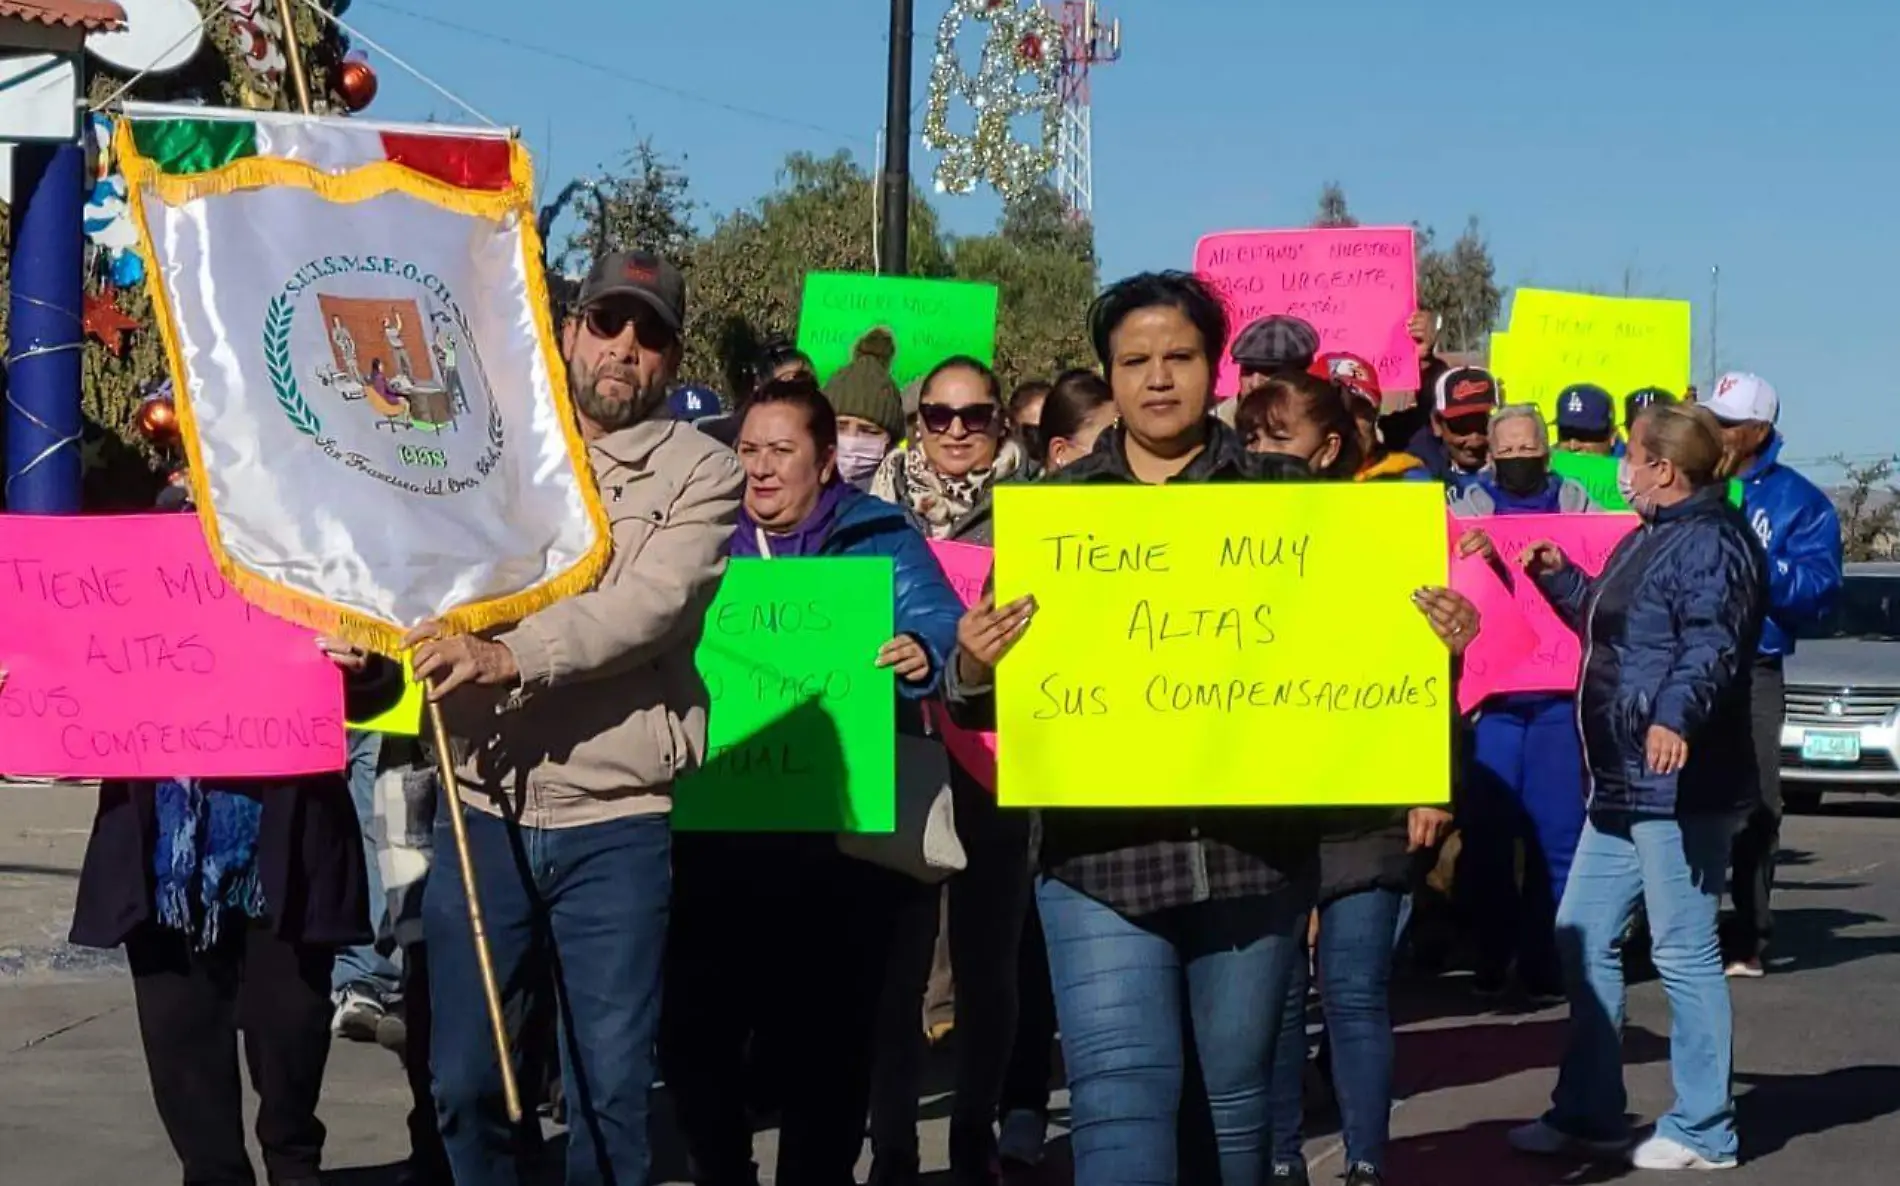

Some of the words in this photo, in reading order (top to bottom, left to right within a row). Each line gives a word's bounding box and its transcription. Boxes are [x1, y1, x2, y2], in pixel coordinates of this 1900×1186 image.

[424, 478, 442, 496] del
[1219, 533, 1311, 577] MUY
[0, 558, 132, 609] TIENE
[157, 562, 240, 615] MU
[716, 600, 832, 636] EMOS
[1127, 599, 1276, 651] ALTAS
[2, 686, 81, 719] SUS
[755, 667, 851, 701] PAGO
[1033, 673, 1109, 720] SUS
[1146, 673, 1438, 715] COMPENSACIONES
